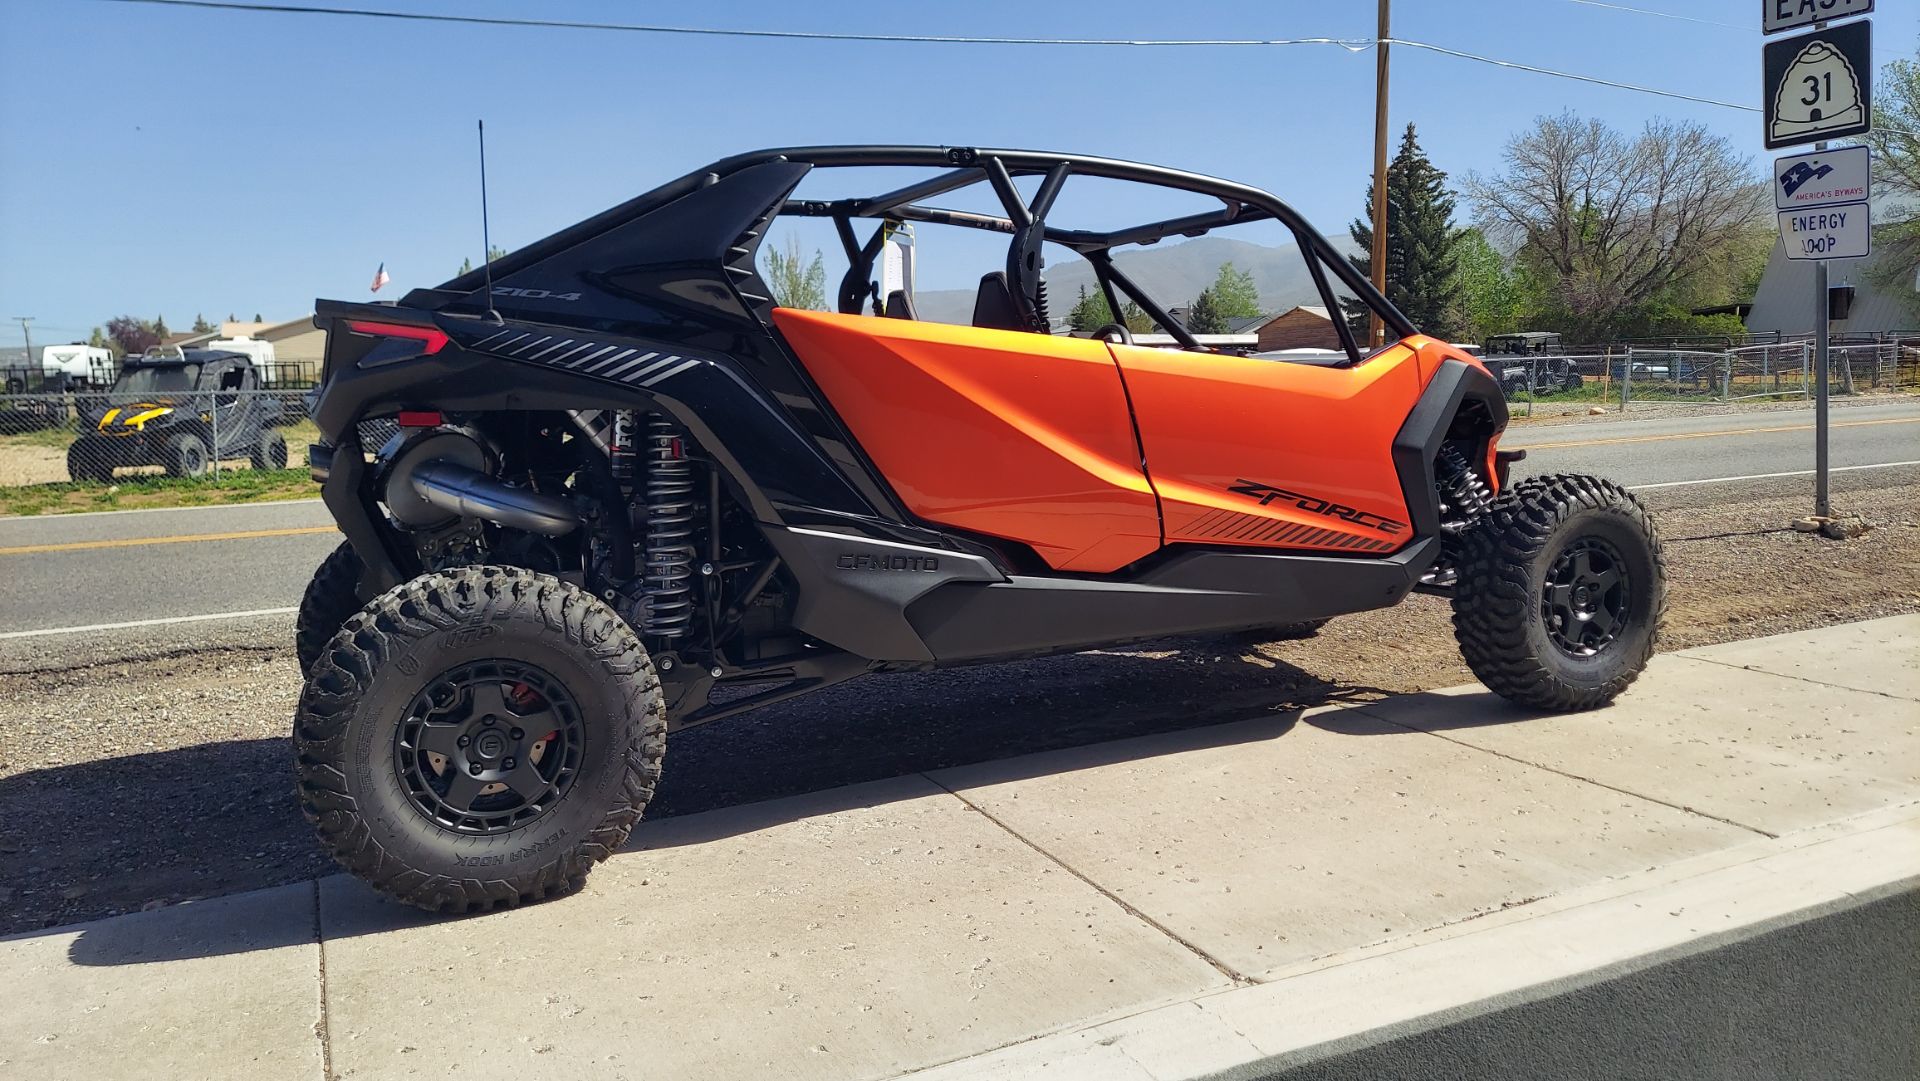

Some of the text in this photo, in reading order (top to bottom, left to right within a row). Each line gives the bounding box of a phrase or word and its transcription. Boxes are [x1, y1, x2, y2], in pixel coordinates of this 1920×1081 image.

[1776, 0, 1852, 20] EA
[1801, 71, 1831, 106] 31
[1795, 187, 1864, 201] AMERICA'S BYWAYS
[1792, 212, 1847, 232] ENERGY
[615, 409, 633, 447] FOX
[1227, 478, 1408, 535] ZFORCE
[835, 552, 939, 573] CFMOTO
[453, 827, 569, 867] TERRA HOOK
